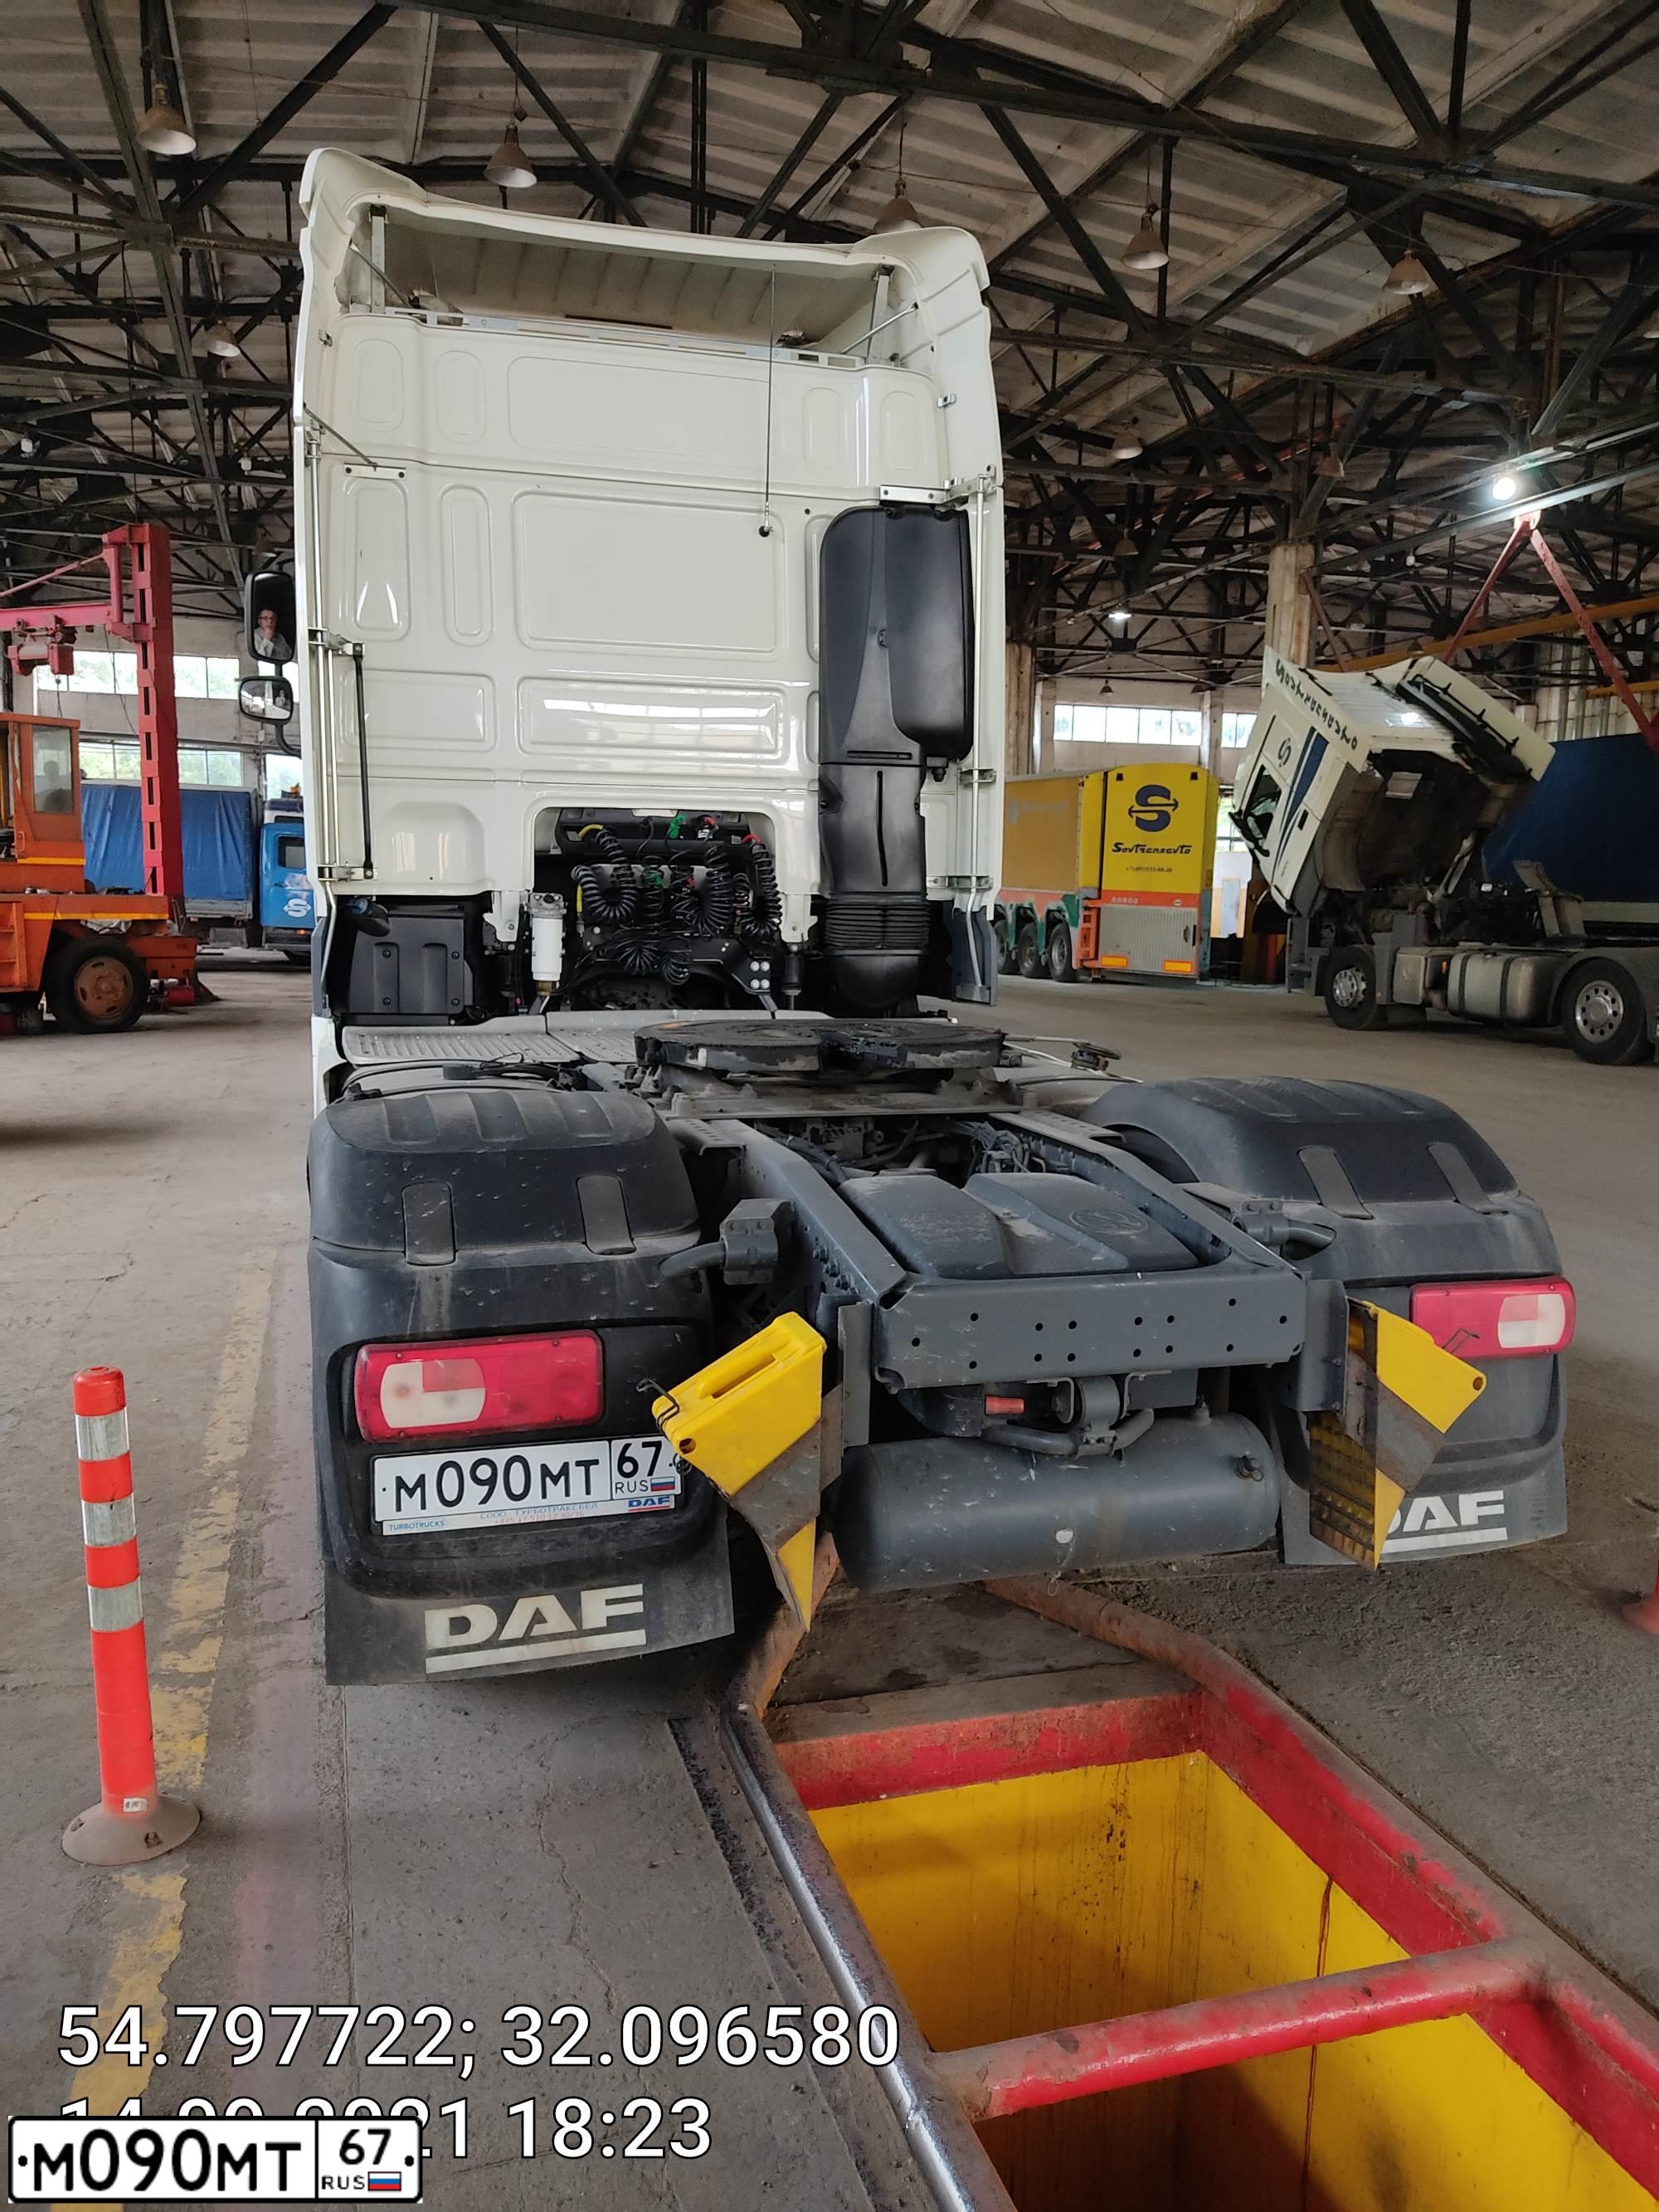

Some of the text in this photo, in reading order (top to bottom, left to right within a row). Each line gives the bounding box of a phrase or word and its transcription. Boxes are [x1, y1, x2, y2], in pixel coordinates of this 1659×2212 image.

[617, 1440, 663, 1479] 67
[615, 1479, 649, 1494] RUS
[628, 1495, 670, 1508] DAF
[1388, 1490, 1505, 1534] AF
[388, 1519, 445, 1531] TURBOTRUCKS
[425, 1584, 644, 1650] DAF
